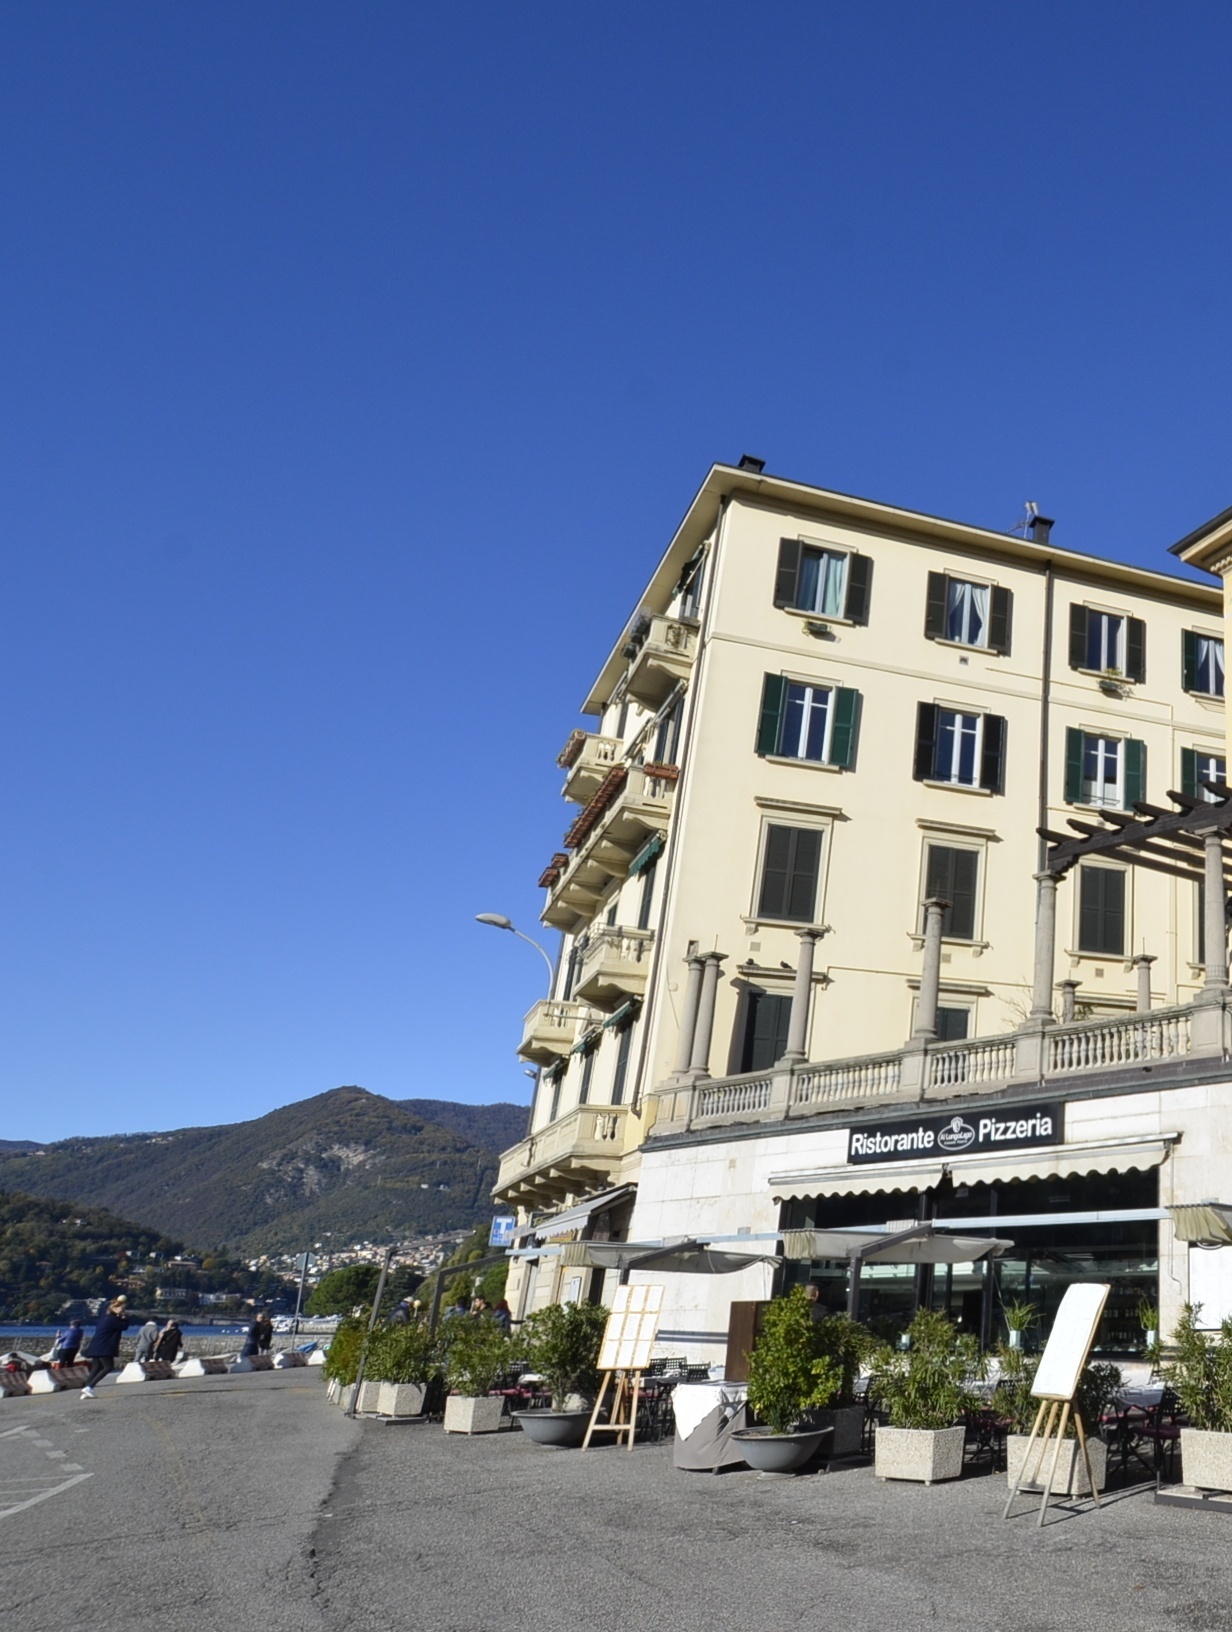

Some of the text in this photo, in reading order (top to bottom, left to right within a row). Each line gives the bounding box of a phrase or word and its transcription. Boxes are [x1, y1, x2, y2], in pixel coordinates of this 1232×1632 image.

[851, 1126, 934, 1155] Ristorante
[979, 1112, 1052, 1142] Pizzeria
[496, 1218, 513, 1234] T
